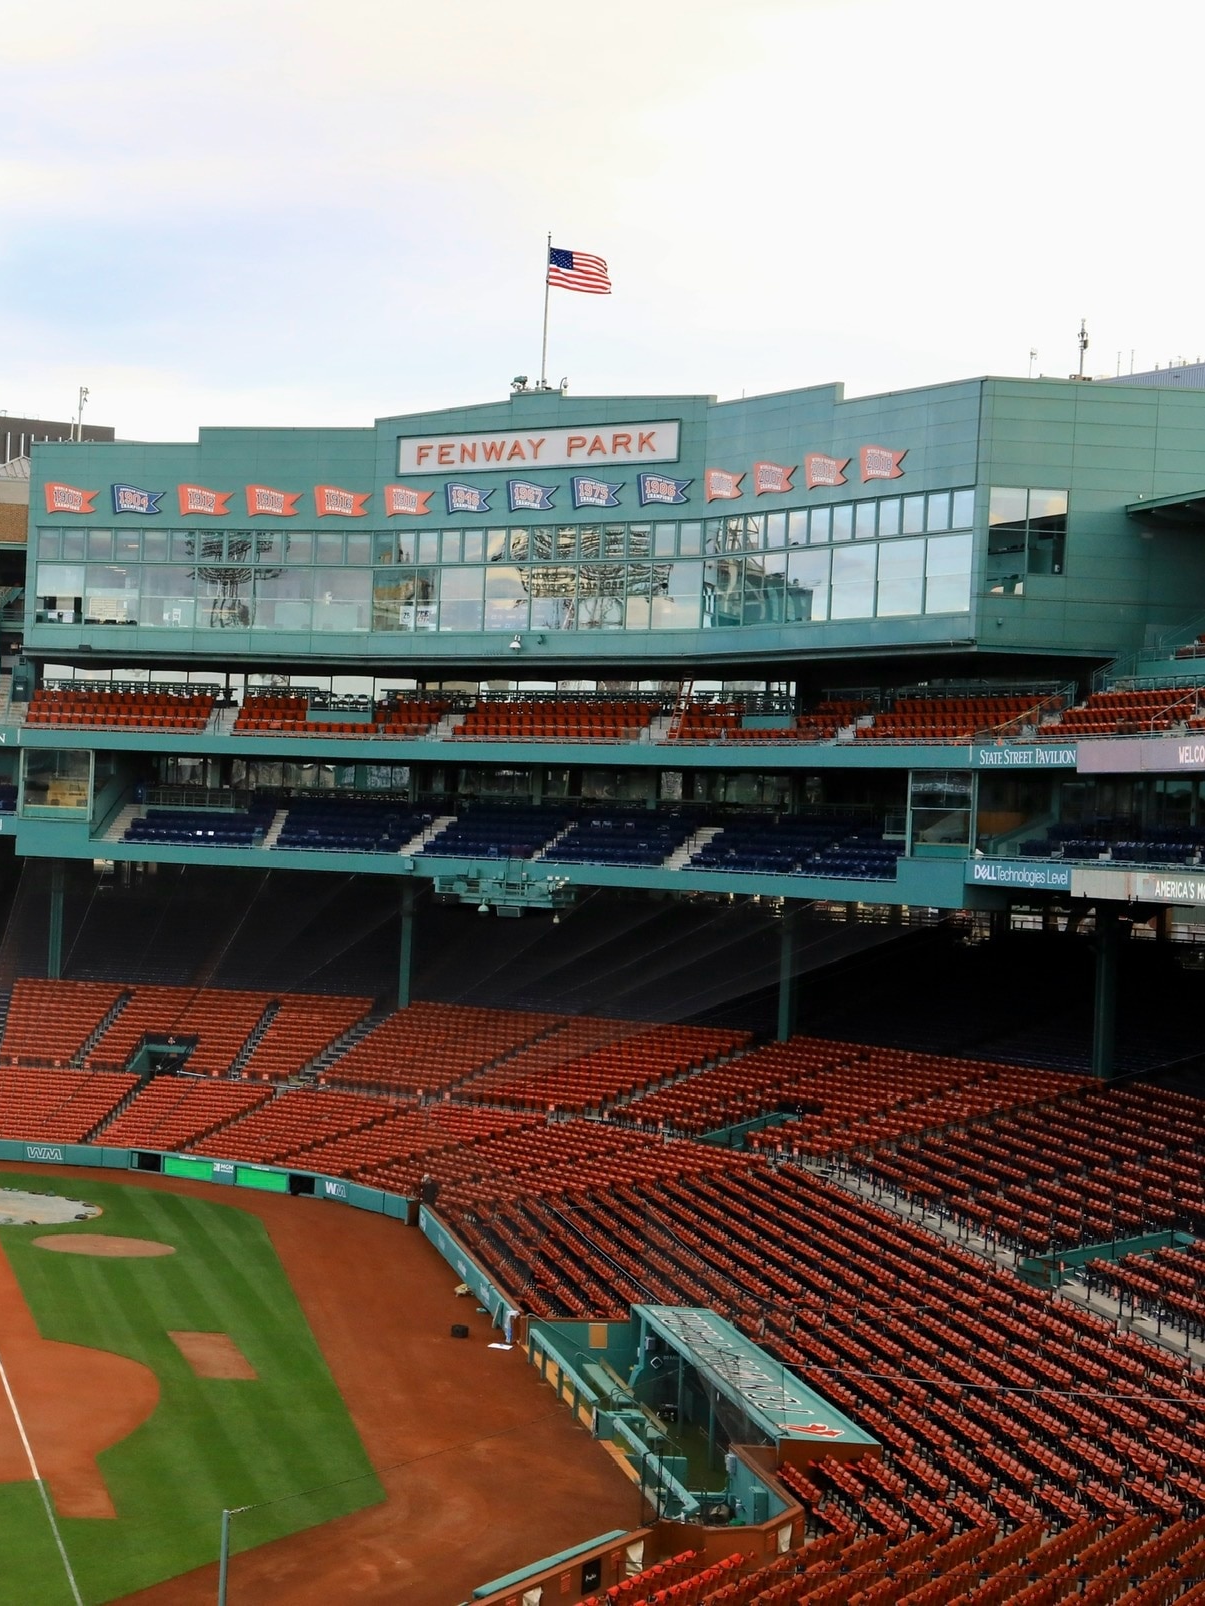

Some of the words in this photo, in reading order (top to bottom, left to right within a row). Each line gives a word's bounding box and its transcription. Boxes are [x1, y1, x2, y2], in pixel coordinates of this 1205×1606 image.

[417, 437, 545, 465] FENWAY
[566, 431, 656, 457] PARK
[54, 490, 82, 506] 1903
[119, 492, 148, 508] 1904
[188, 492, 215, 508] 1912
[452, 490, 479, 506] 1946
[579, 484, 608, 500] 1975
[256, 493, 283, 509] 1915
[325, 493, 353, 510] 1916
[980, 750, 1003, 765] STATE
[1004, 749, 1032, 764] STREET
[1035, 748, 1076, 764] PAVILION
[974, 864, 996, 880] DELL
[996, 866, 1046, 886] Technologies
[1047, 870, 1068, 884] Level
[1155, 880, 1194, 898] AMERICA'S
[27, 1147, 63, 1160] WM
[325, 1181, 346, 1198] WM
